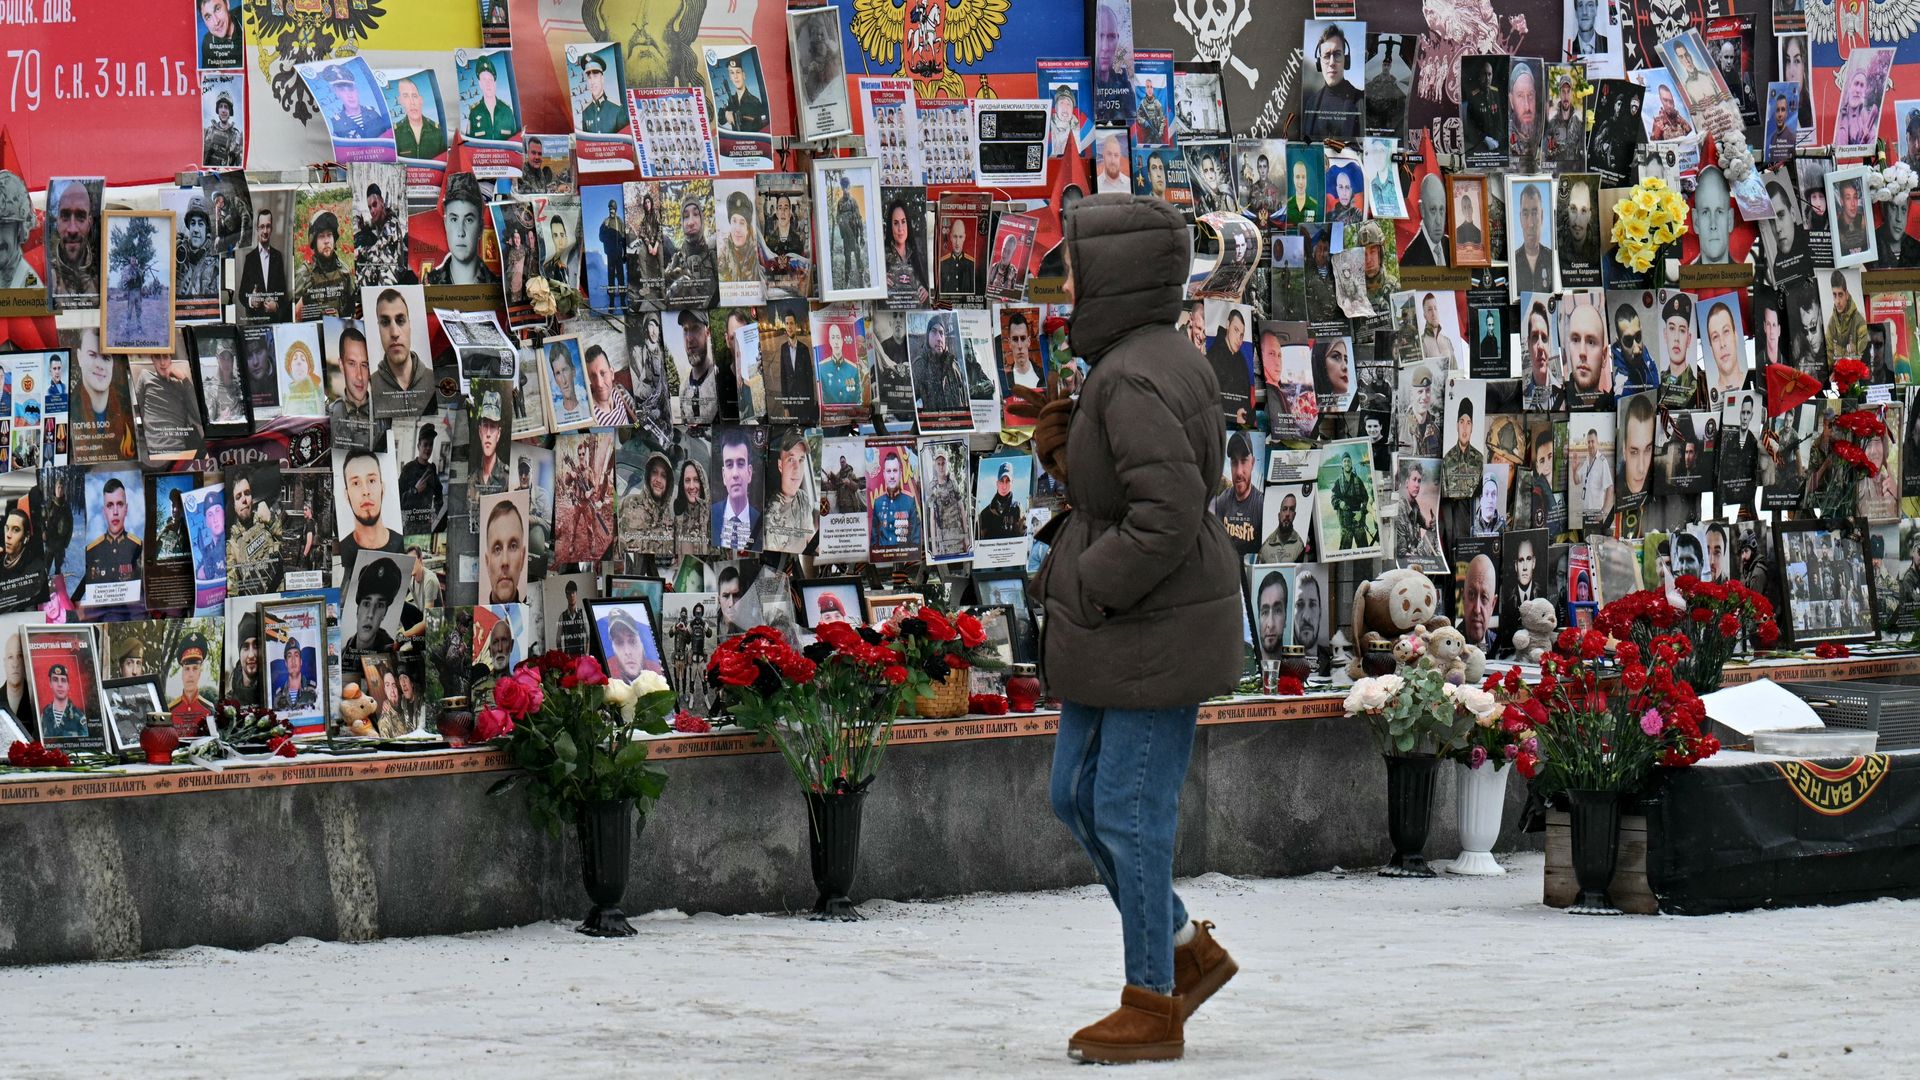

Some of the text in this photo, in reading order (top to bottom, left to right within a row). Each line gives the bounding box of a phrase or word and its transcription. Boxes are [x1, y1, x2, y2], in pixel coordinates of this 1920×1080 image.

[7, 49, 41, 112] 79
[95, 58, 109, 97] 3
[1167, 170, 1187, 183] БОЛОТ
[1033, 286, 1055, 295] Фомин
[830, 516, 860, 525] ЮРИЙ ВОЛК
[1223, 516, 1255, 542] CrossFit
[1774, 668, 1826, 680] ВЕЧНАЯ ПАМЯТЬ
[1848, 664, 1900, 676] ВЕЧНАЯ ПАМЯТЬ
[1725, 672, 1752, 683] ПАМЯТЬ
[1217, 707, 1276, 719] ВЕЧНАЯ ПАМЯТЬ
[1302, 703, 1330, 714] ВЕЧНАЯ
[955, 722, 1018, 736] ВЕЧНАЯ ПАМЯТЬ
[1044, 720, 1059, 730] ВЕЧ
[896, 727, 928, 739] ПАМЯТЬ
[677, 739, 744, 753] ВЕЧНАЯ ПАМЯТЬ
[384, 759, 455, 773] ВЕЧНАЯ ПАМЯТЬ
[485, 753, 515, 767] ВЕЧНА
[178, 772, 251, 788] ВЕЧНАЯ ПАМЯТЬ
[282, 766, 354, 781] ВЕЧНАЯ ПАМЯТЬ
[72, 780, 147, 796] ВЕЧНАЯ ПАМЯТЬ
[1786, 762, 1853, 806] ВАГНЕР
[1, 787, 40, 800] ПАМЯТЬ
